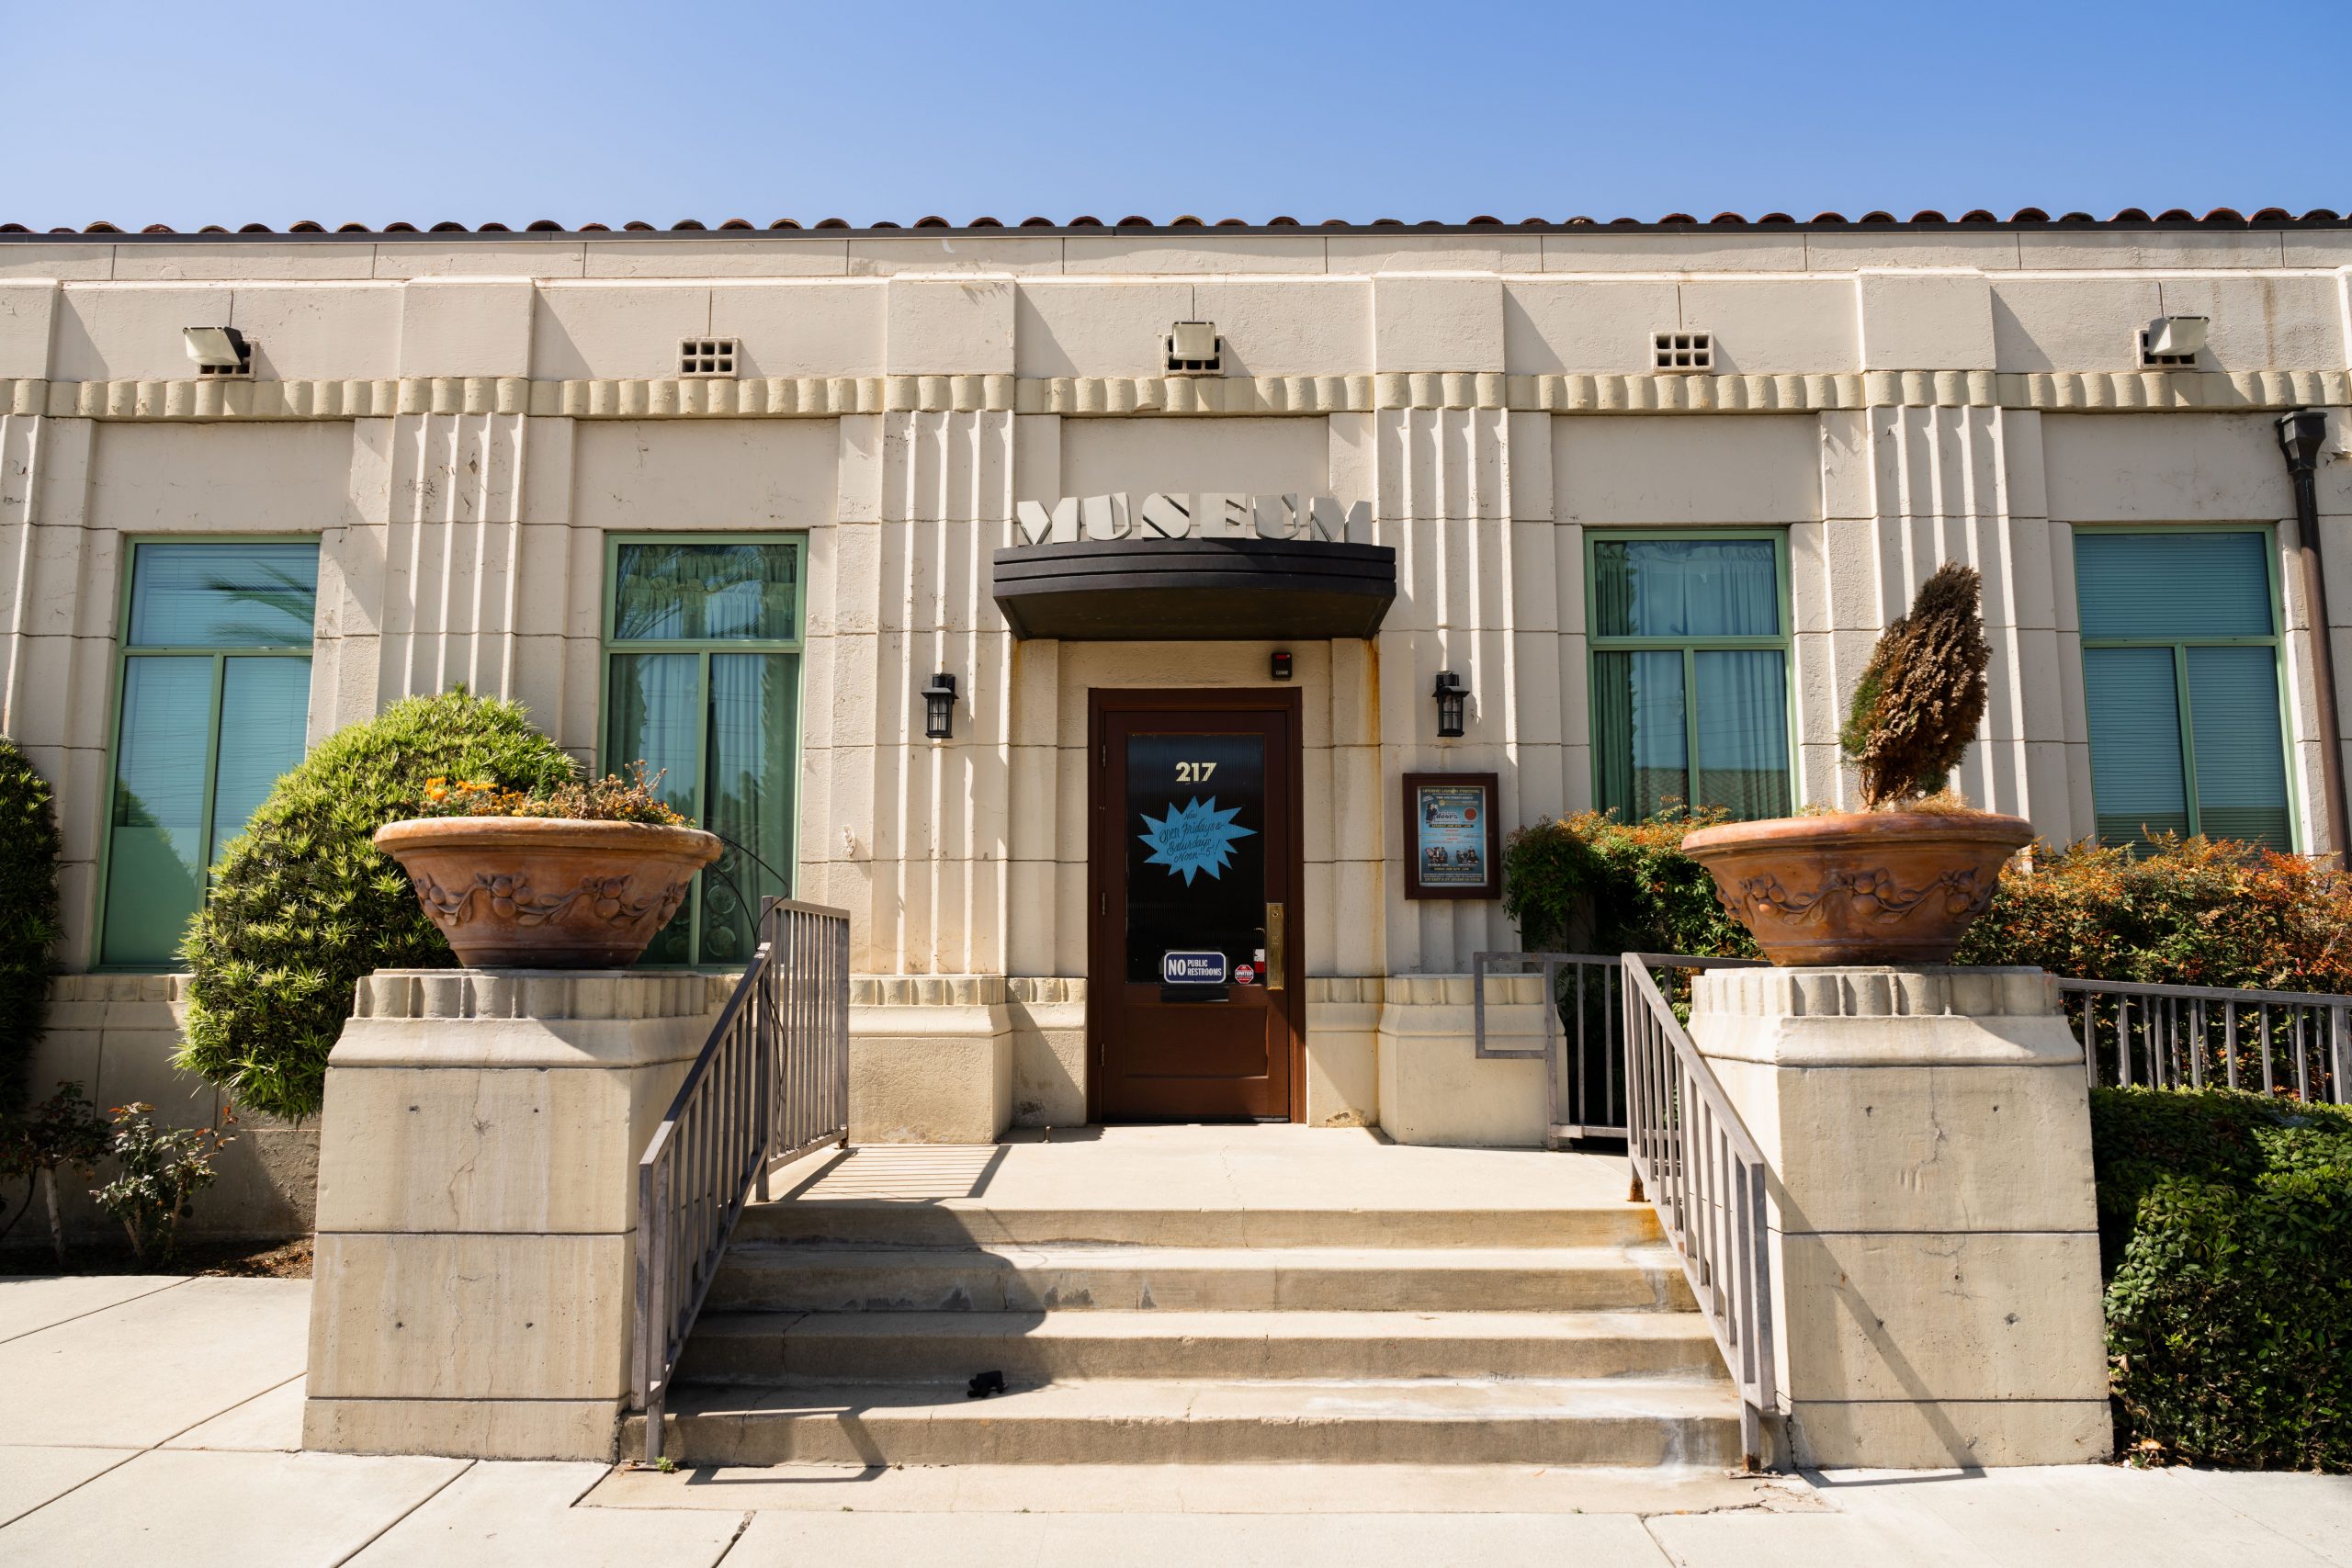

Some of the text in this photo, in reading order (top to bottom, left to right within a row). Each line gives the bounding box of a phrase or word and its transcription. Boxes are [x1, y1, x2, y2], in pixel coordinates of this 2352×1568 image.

[1017, 492, 1373, 545] MUSEUM
[1175, 761, 1217, 782] 217
[1159, 828, 1181, 845] Open
[1182, 818, 1215, 841] Fridays
[1166, 835, 1212, 856] Saturdays
[1168, 959, 1186, 976] NO
[1187, 959, 1208, 967] PUBLIC
[1187, 967, 1222, 976] RESTROOMS
